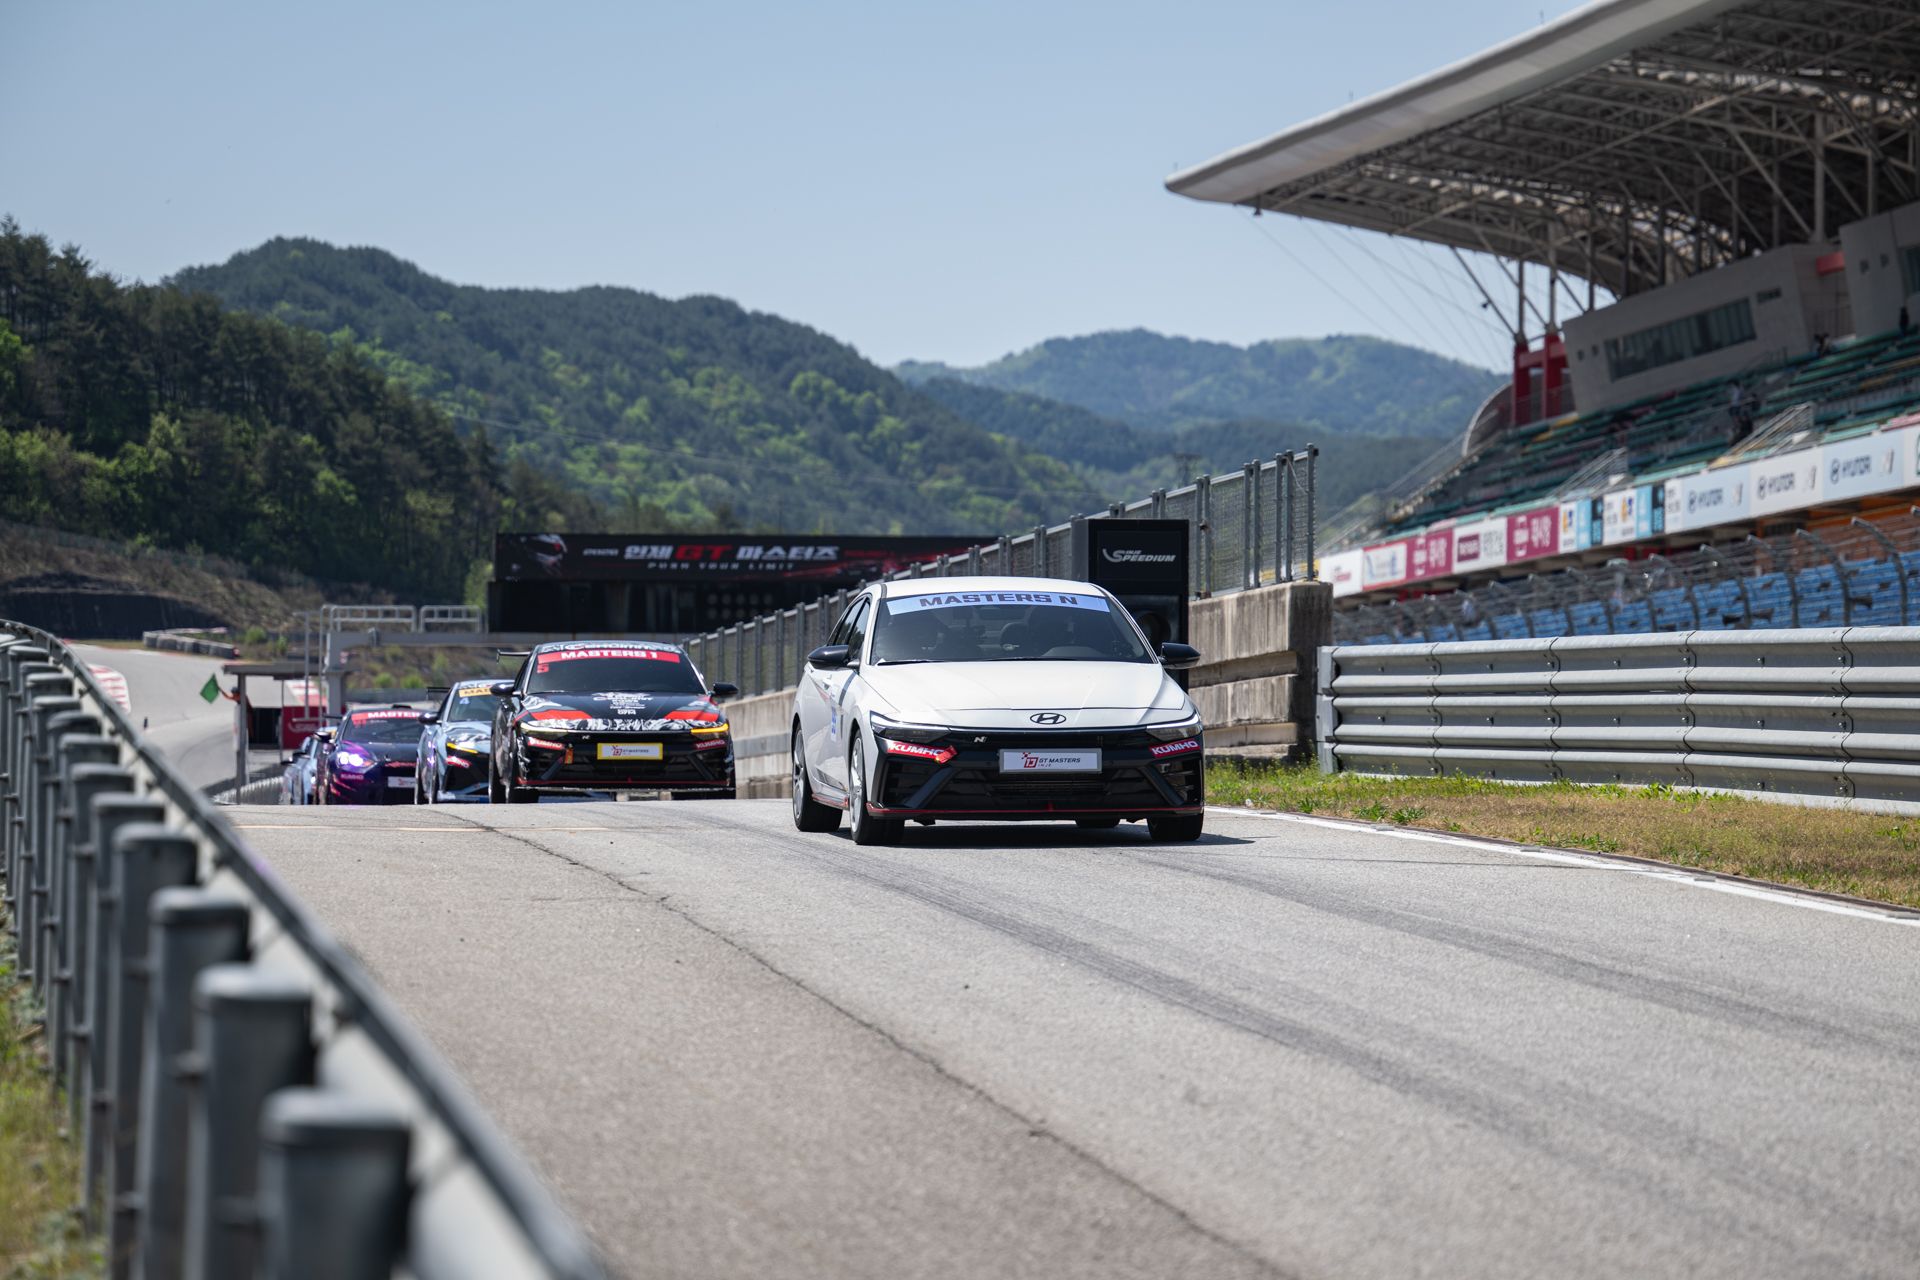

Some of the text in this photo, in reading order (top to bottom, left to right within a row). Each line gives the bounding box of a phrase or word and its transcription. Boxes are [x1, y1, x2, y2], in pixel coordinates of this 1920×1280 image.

[1103, 549, 1177, 563] SPEEDIUM
[749, 562, 794, 570] LIMIT
[919, 593, 1078, 607] MASTERS N
[561, 649, 659, 660] MASTERS 1
[536, 664, 550, 674] 5
[1151, 740, 1199, 755] KUMHO
